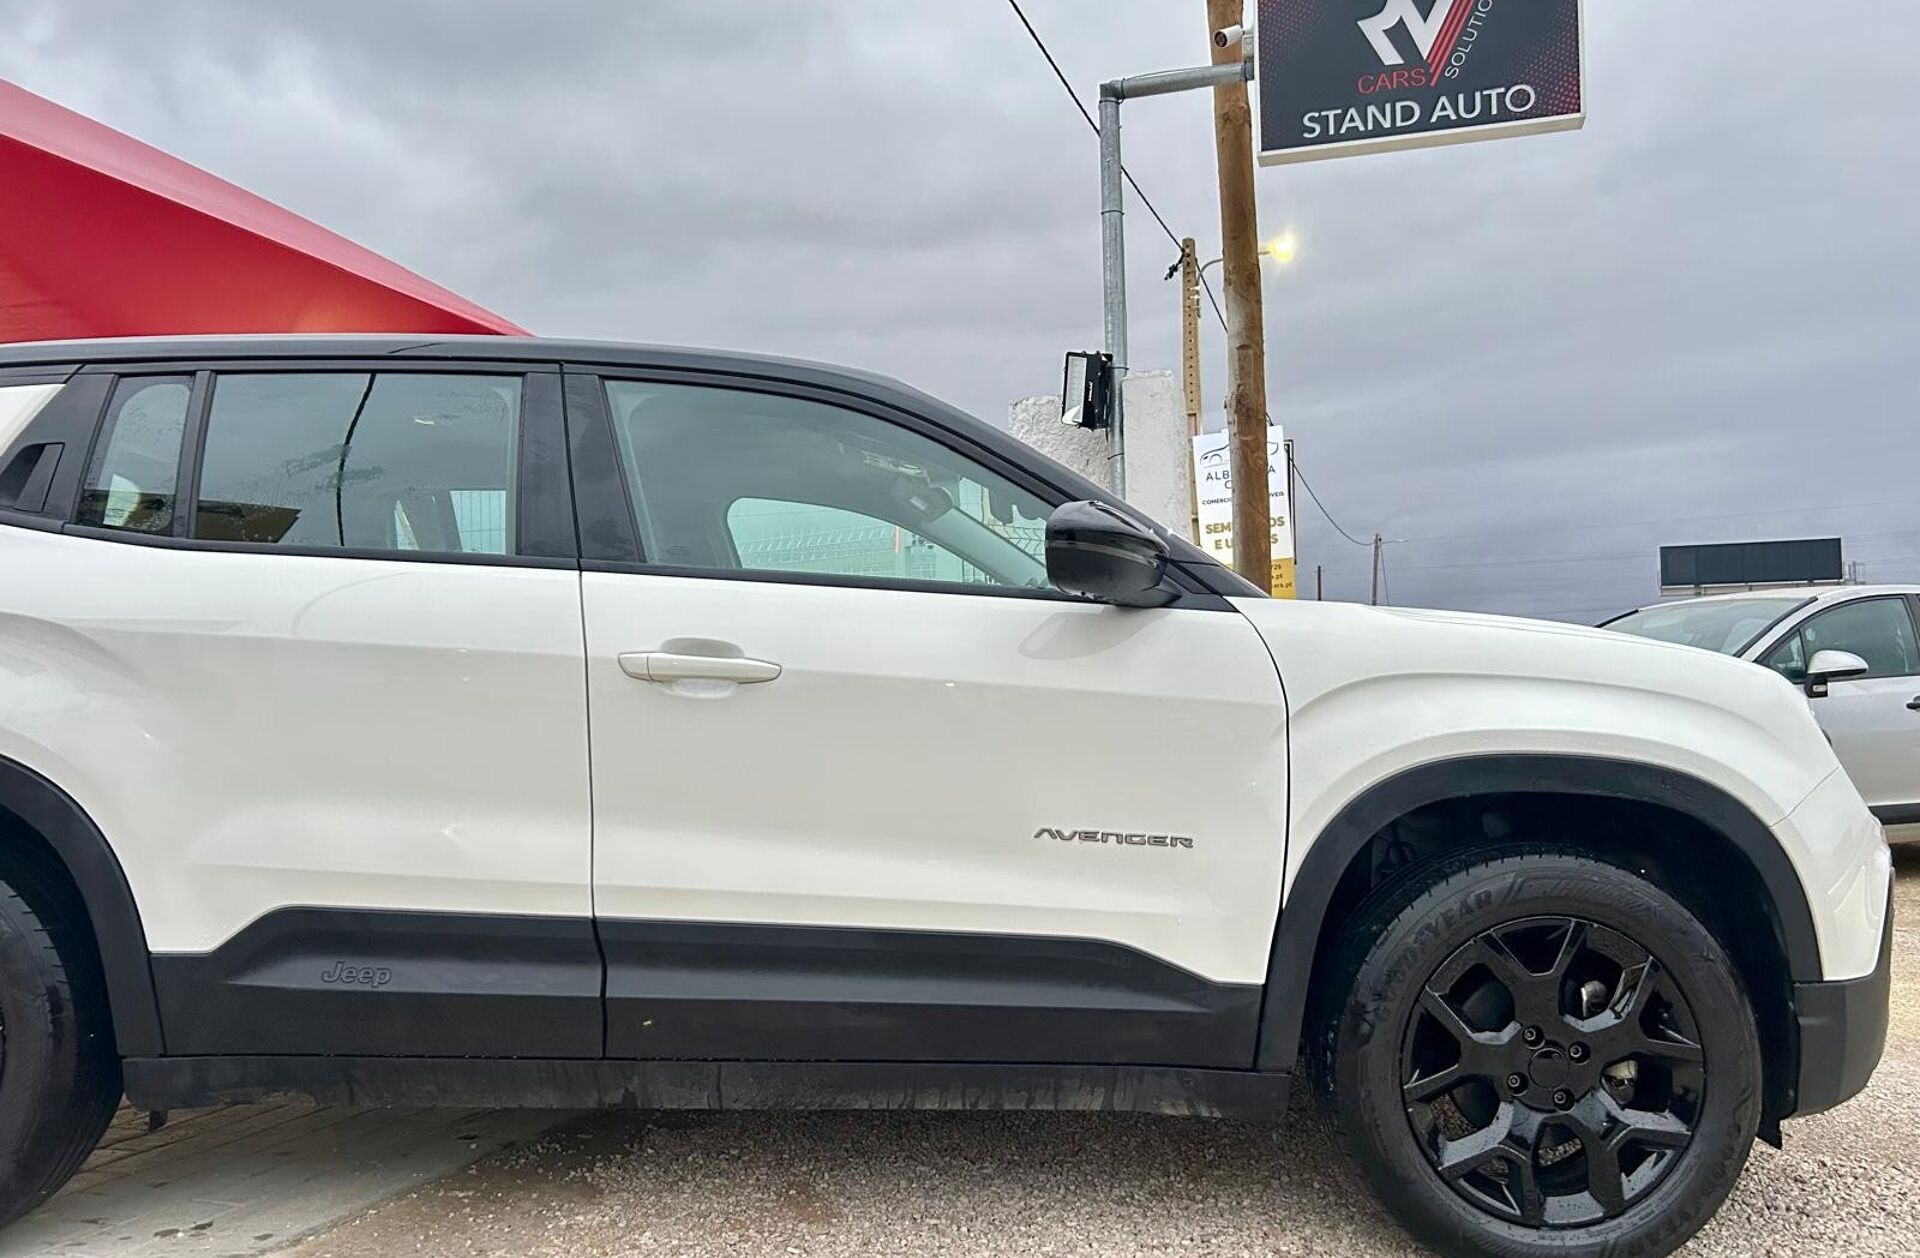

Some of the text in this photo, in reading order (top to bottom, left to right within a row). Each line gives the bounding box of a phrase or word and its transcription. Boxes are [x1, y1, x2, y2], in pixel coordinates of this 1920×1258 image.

[1356, 67, 1427, 94] CARS
[1302, 84, 1536, 138] STAND AUTO
[1033, 828, 1194, 848] AVENGER
[321, 960, 392, 988] Jeep
